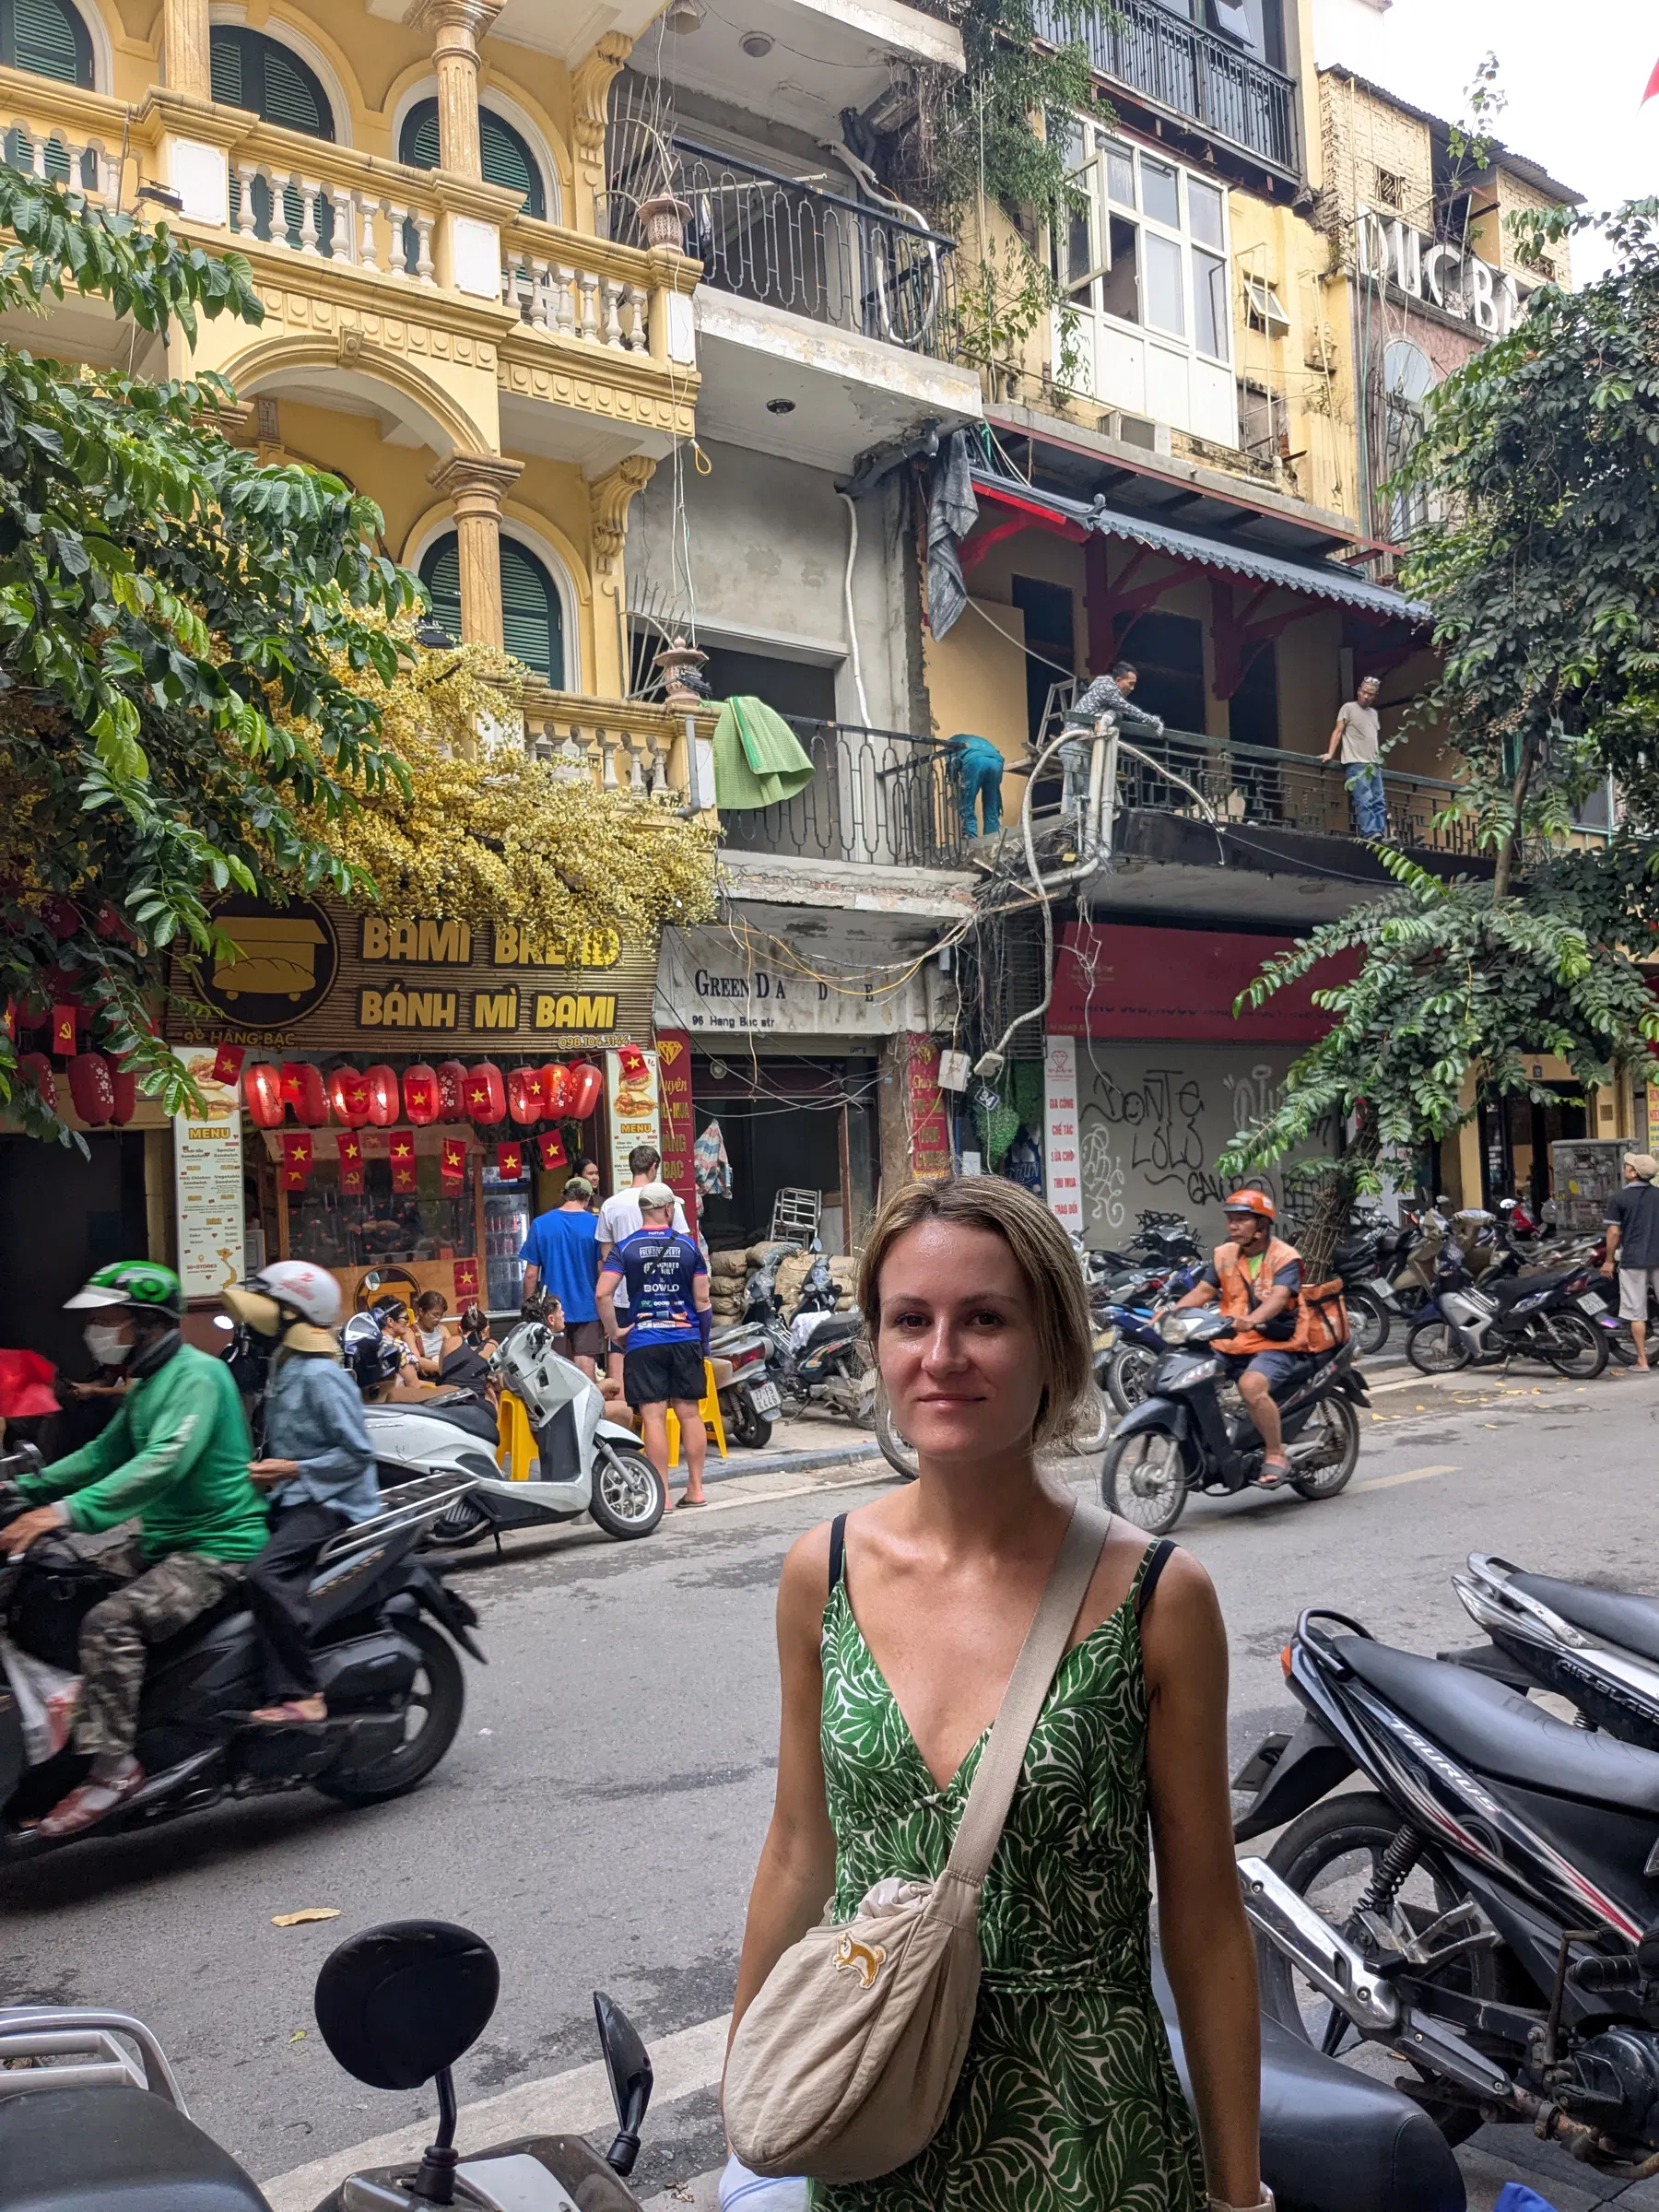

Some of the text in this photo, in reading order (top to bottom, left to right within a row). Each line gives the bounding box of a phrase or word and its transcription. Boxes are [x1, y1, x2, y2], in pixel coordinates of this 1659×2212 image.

[362, 917, 470, 963] BAMI
[695, 970, 748, 996] GREEN
[360, 984, 616, 1029] BÁNH MÌ BAMI
[692, 1016, 704, 1026] 96
[761, 1018, 775, 1028] str
[558, 1034, 631, 1050] 098.104.3144
[660, 1077, 688, 1096] uyên
[979, 1090, 995, 1107] 94
[189, 1127, 230, 1140] MENU
[620, 1123, 652, 1134] MENU
[662, 1130, 687, 1152] ÀNG
[664, 1159, 685, 1182] BẠC
[643, 1283, 680, 1293] BOWLO
[1390, 1717, 1501, 1813] TAURUS
